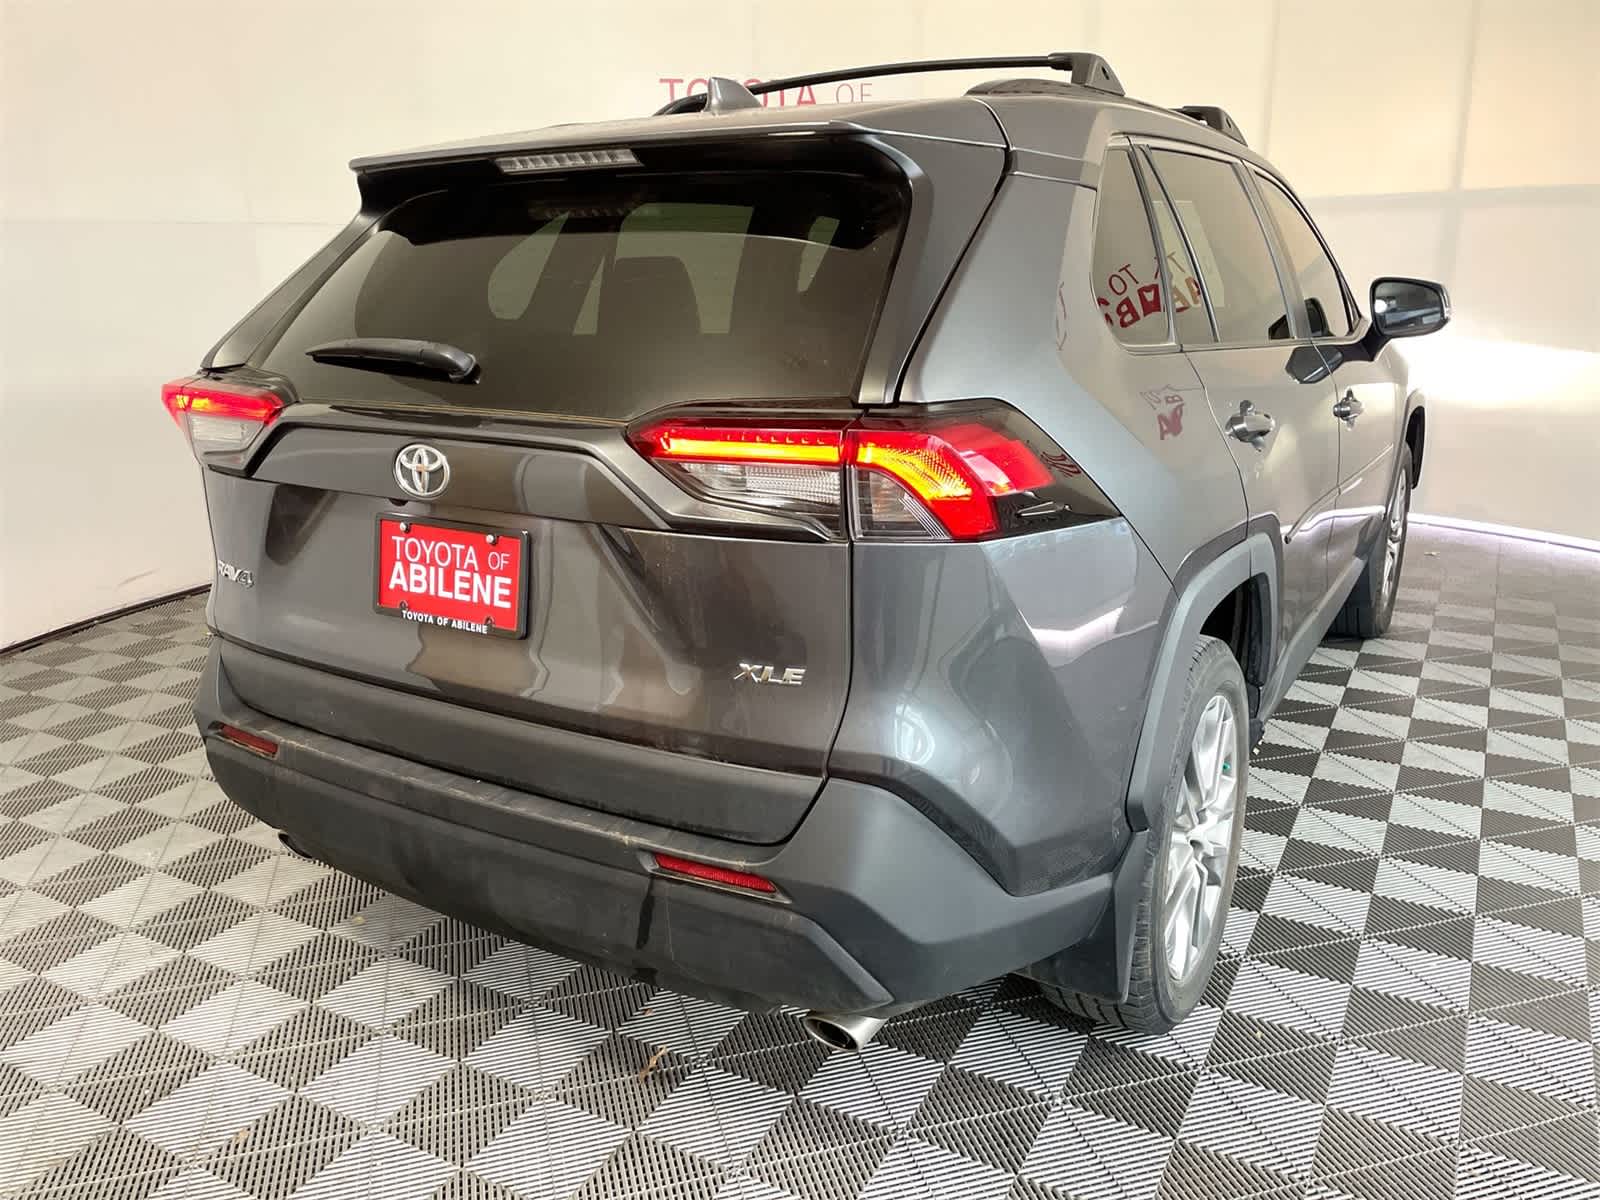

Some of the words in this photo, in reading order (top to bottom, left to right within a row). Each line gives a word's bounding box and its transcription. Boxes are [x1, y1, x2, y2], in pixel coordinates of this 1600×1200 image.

[835, 83, 873, 104] OF
[391, 535, 479, 571] TOYOTA
[487, 551, 511, 570] OF
[217, 559, 254, 588] RAV4
[388, 561, 512, 609] ABILENE
[401, 610, 434, 624] TOYOTA
[436, 616, 449, 626] OF
[451, 619, 488, 634] ABILENE
[733, 662, 806, 685] XLE
